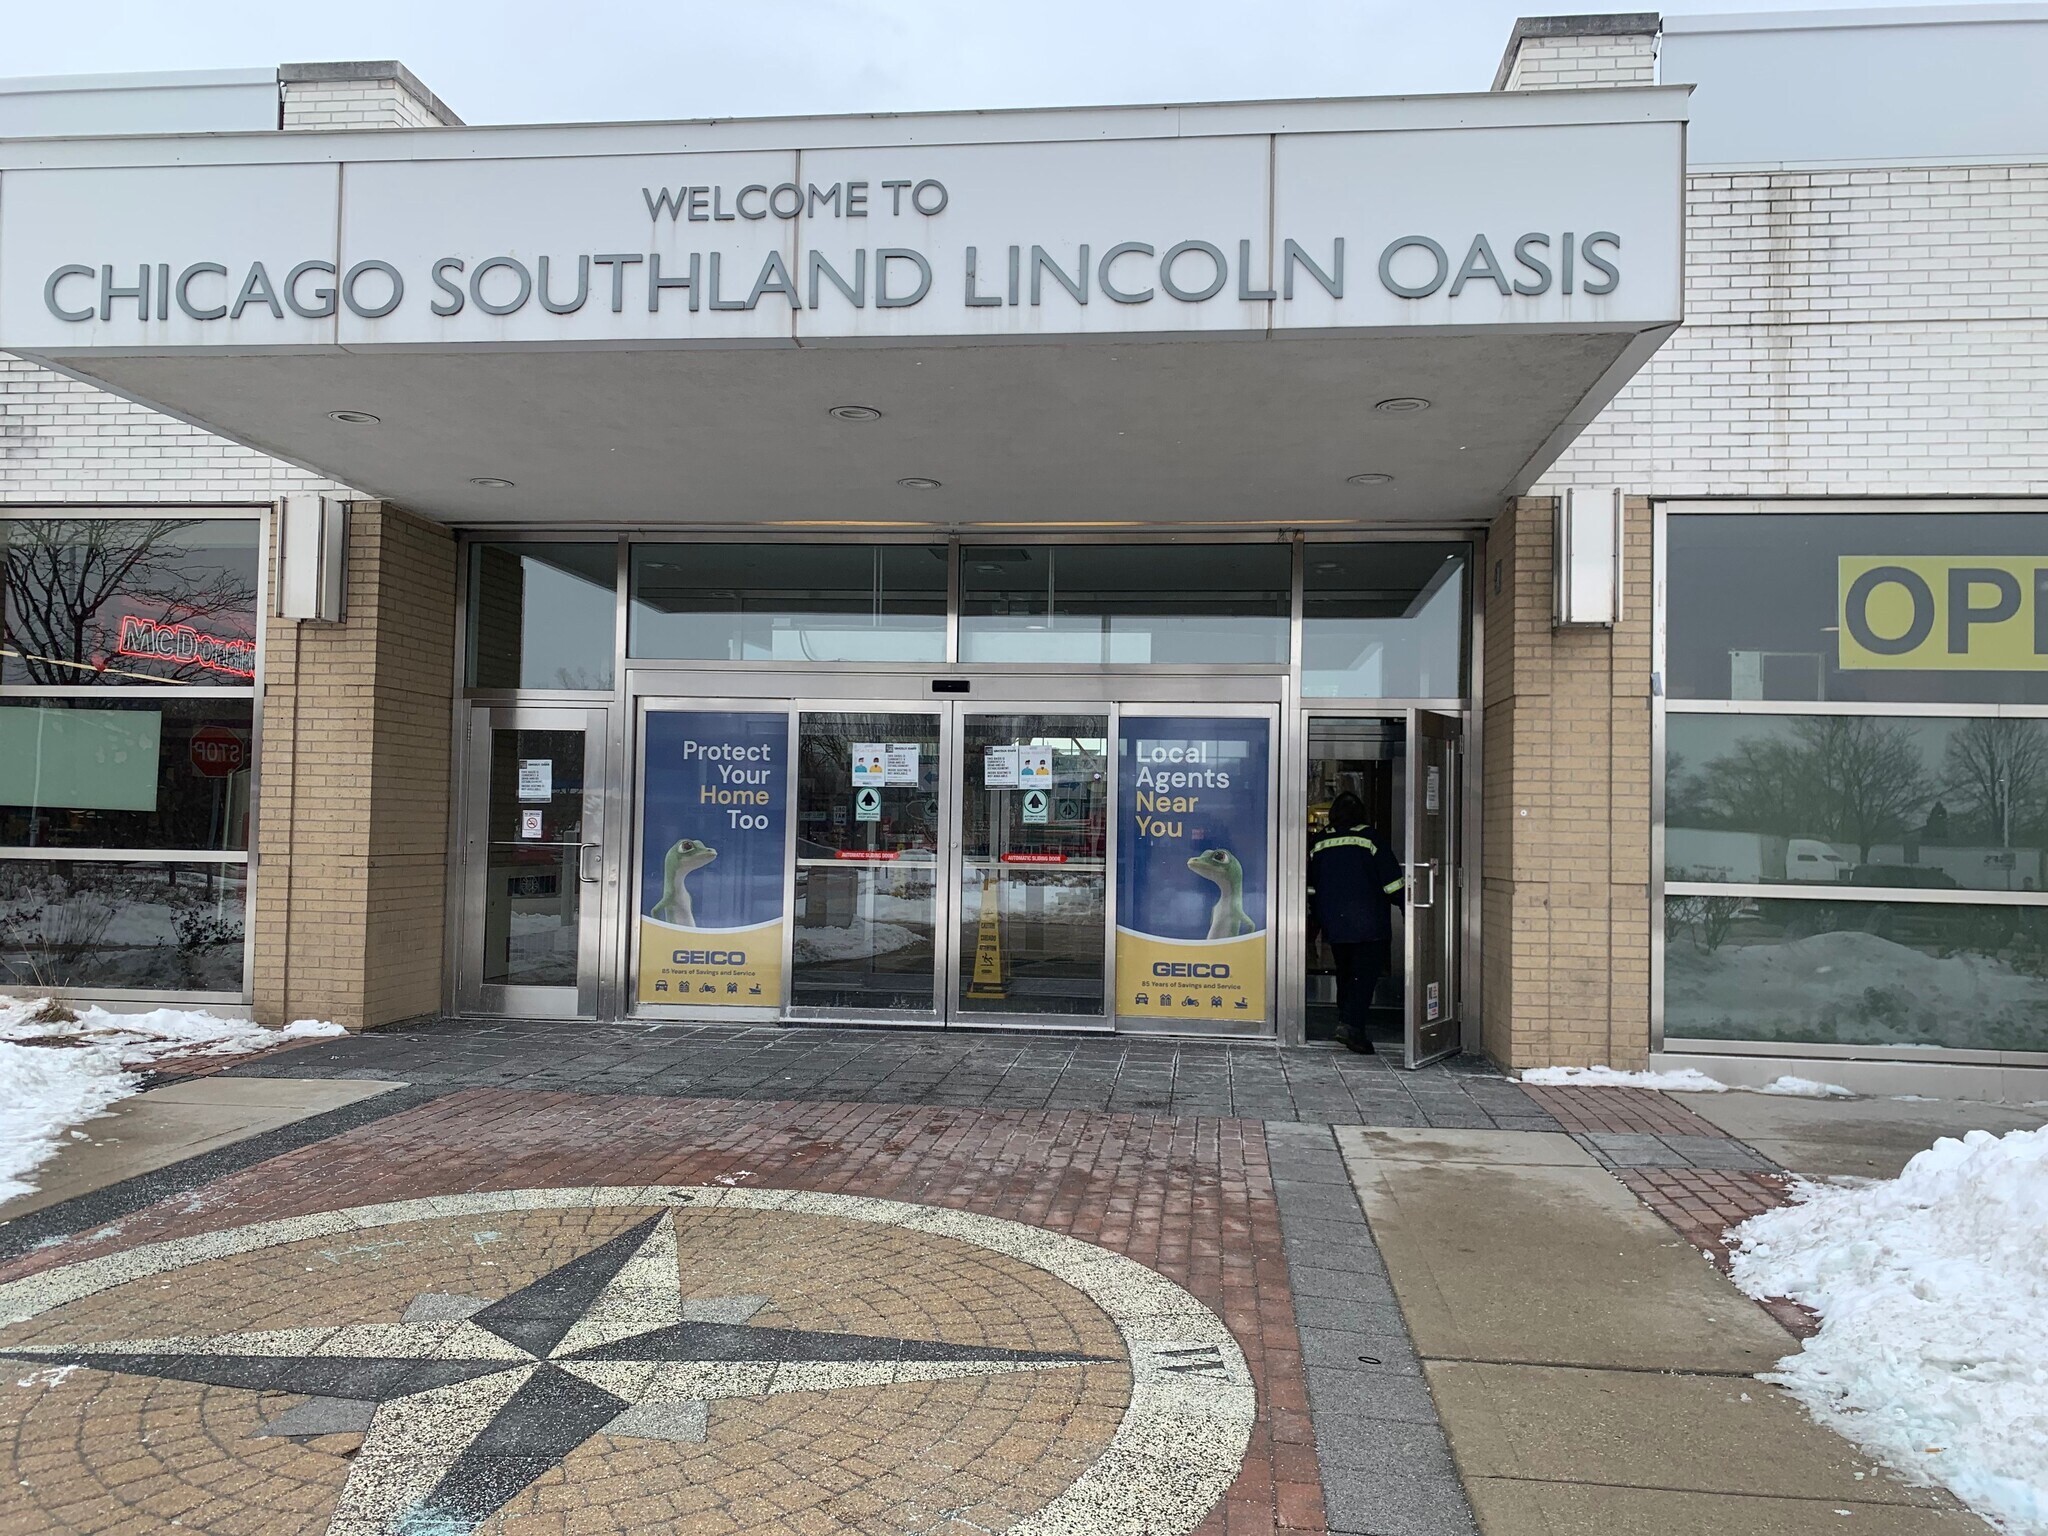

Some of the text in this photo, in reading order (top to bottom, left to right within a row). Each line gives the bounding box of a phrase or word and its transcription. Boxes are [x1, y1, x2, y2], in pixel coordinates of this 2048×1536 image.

[643, 179, 948, 223] WELCOME TO
[44, 231, 1622, 322] CHICAGO SOUTHLAND LINCOLN OASIS
[1845, 565, 2048, 655] OP
[683, 740, 771, 761] Protect
[1136, 741, 1207, 763] Local
[718, 764, 771, 785] Your
[1136, 766, 1230, 794] Agents
[700, 784, 770, 806] Home
[1136, 790, 1199, 813] Near
[726, 809, 769, 830] Too
[1135, 815, 1183, 838] You
[672, 949, 746, 966] GEICO
[696, 969, 719, 977] Savings
[1152, 961, 1231, 979] GEICO
[1177, 982, 1202, 990] Savings
[1152, 1345, 1231, 1382] W
